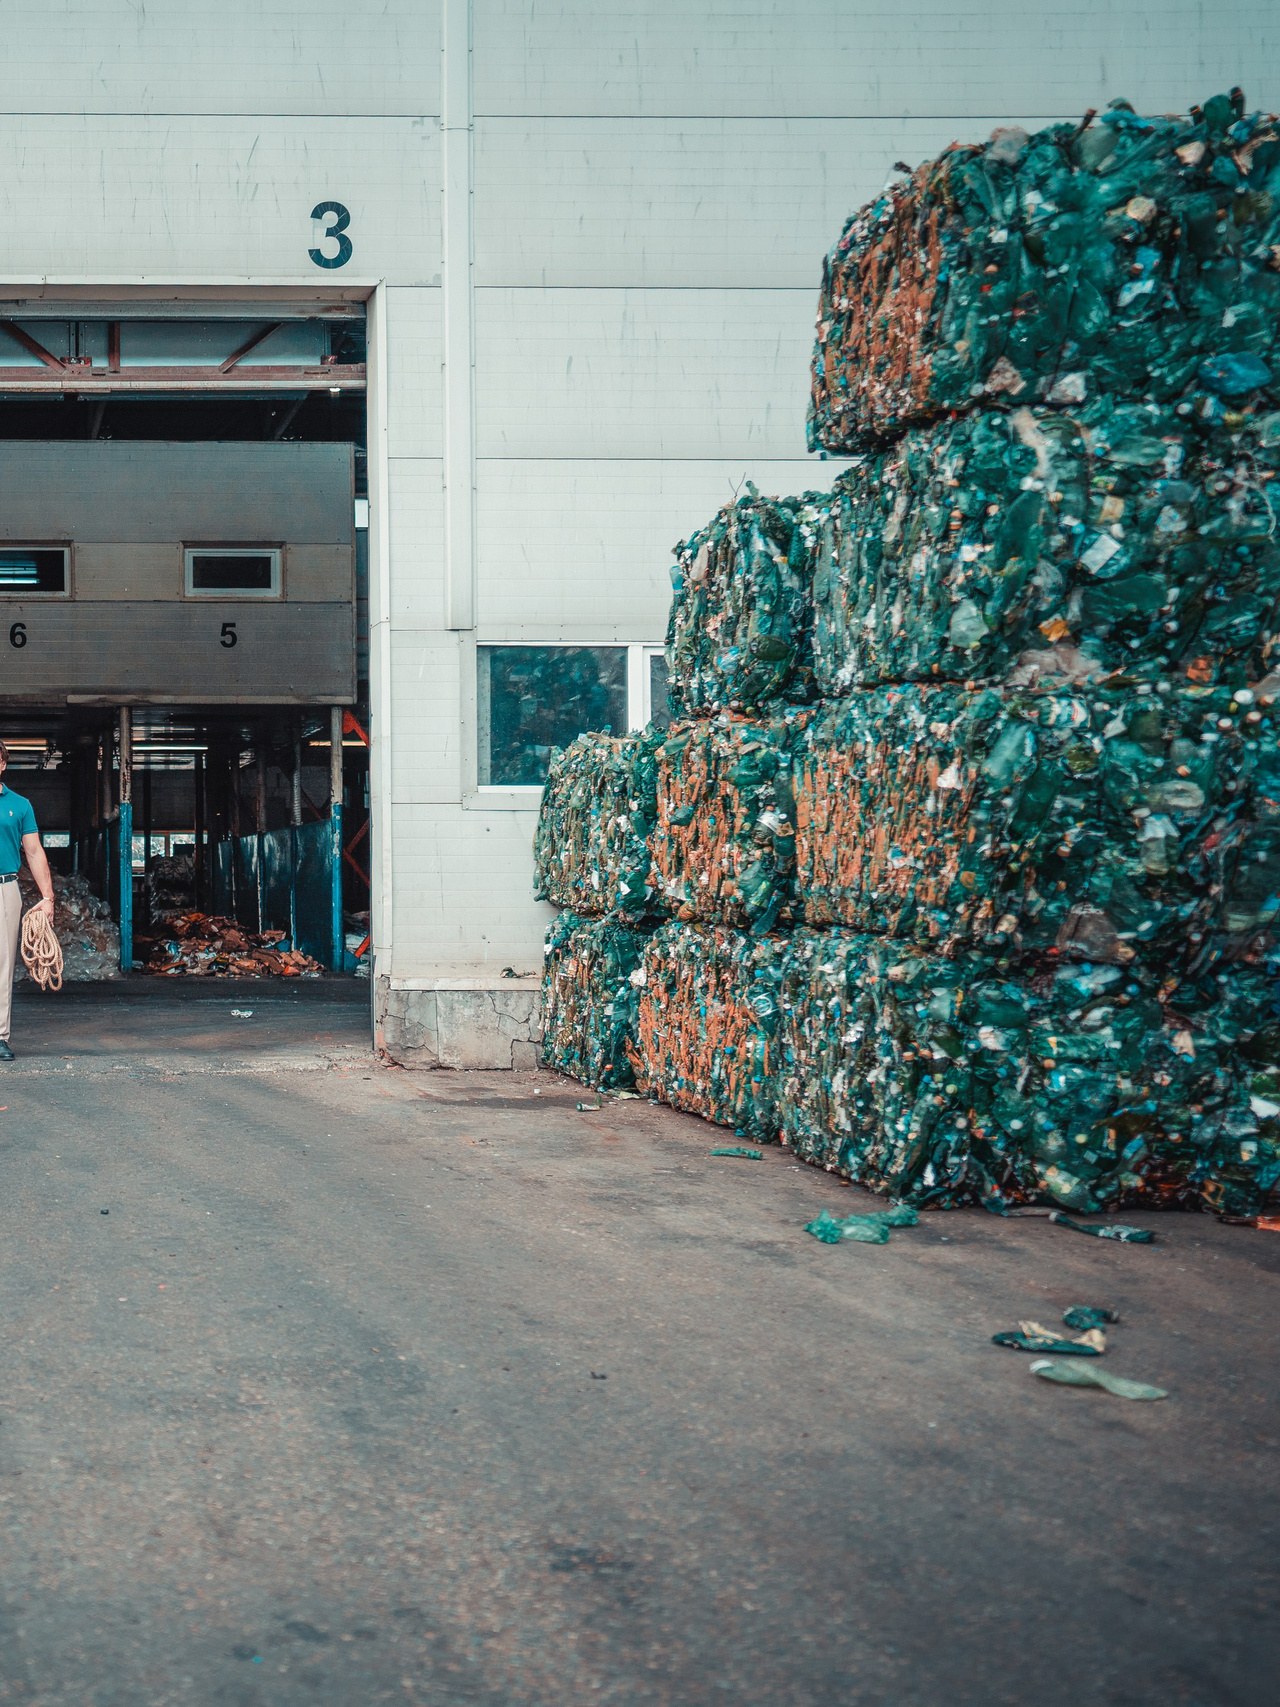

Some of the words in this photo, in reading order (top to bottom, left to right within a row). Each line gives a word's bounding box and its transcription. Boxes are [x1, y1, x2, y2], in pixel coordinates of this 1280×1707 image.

[308, 201, 353, 270] 3
[10, 622, 28, 649] 6
[220, 622, 238, 649] 5
